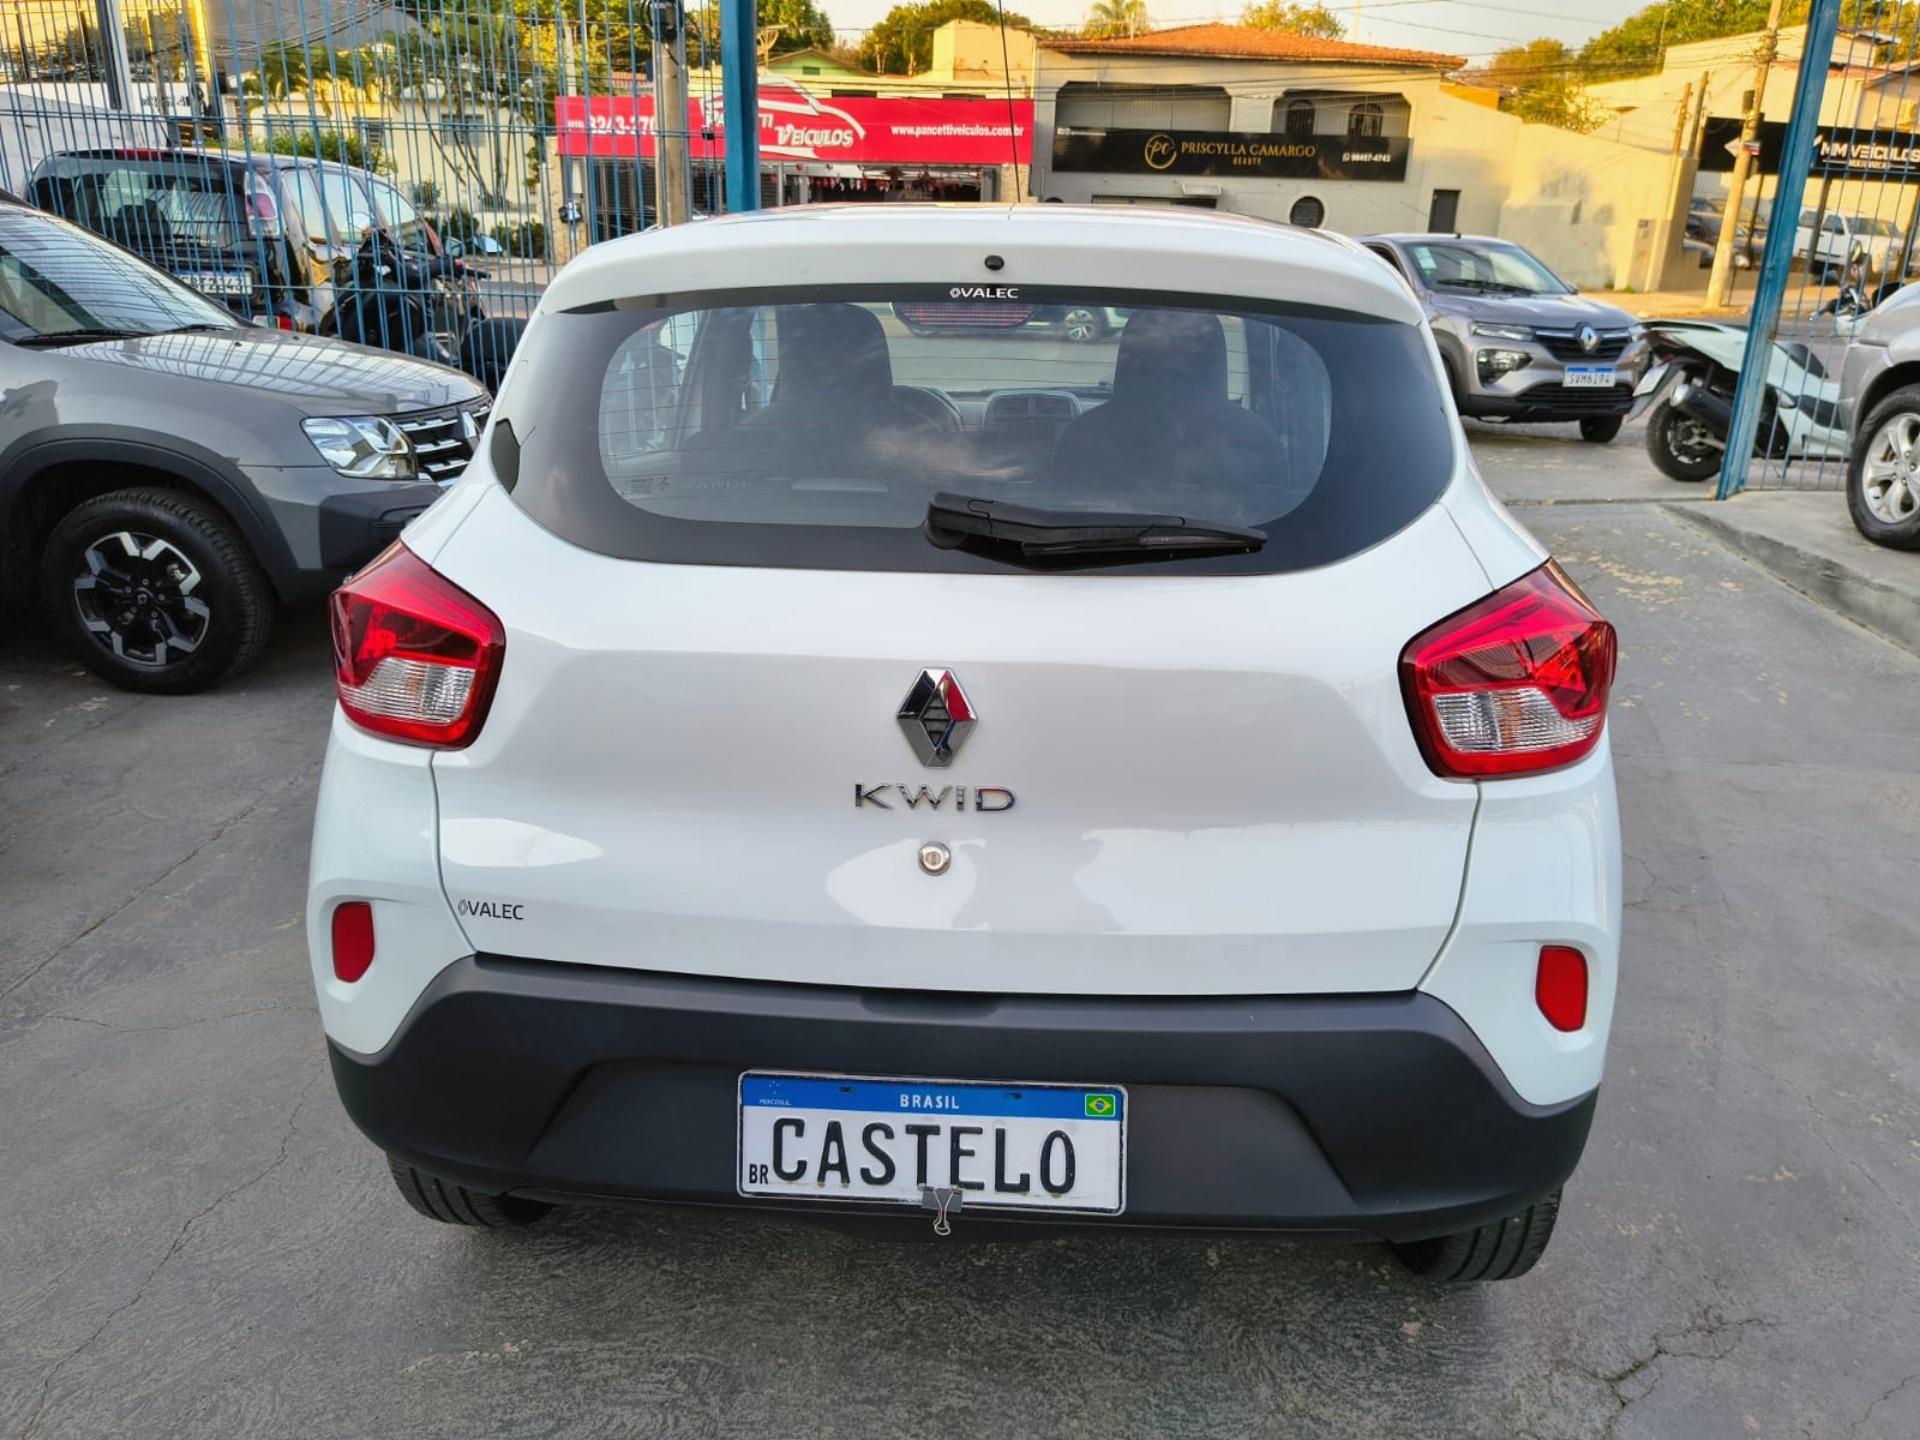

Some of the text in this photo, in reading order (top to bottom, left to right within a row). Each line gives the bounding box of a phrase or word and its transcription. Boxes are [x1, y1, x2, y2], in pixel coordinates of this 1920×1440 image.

[890, 124, 1025, 138] www.pancettiveiculos.combr
[1181, 140, 1316, 158] PRISCYLLA CAMARGO
[854, 782, 1017, 812] KWID
[899, 1093, 961, 1110] BRASIL
[771, 1116, 1077, 1195] CASTELO
[748, 1163, 770, 1186] BR
